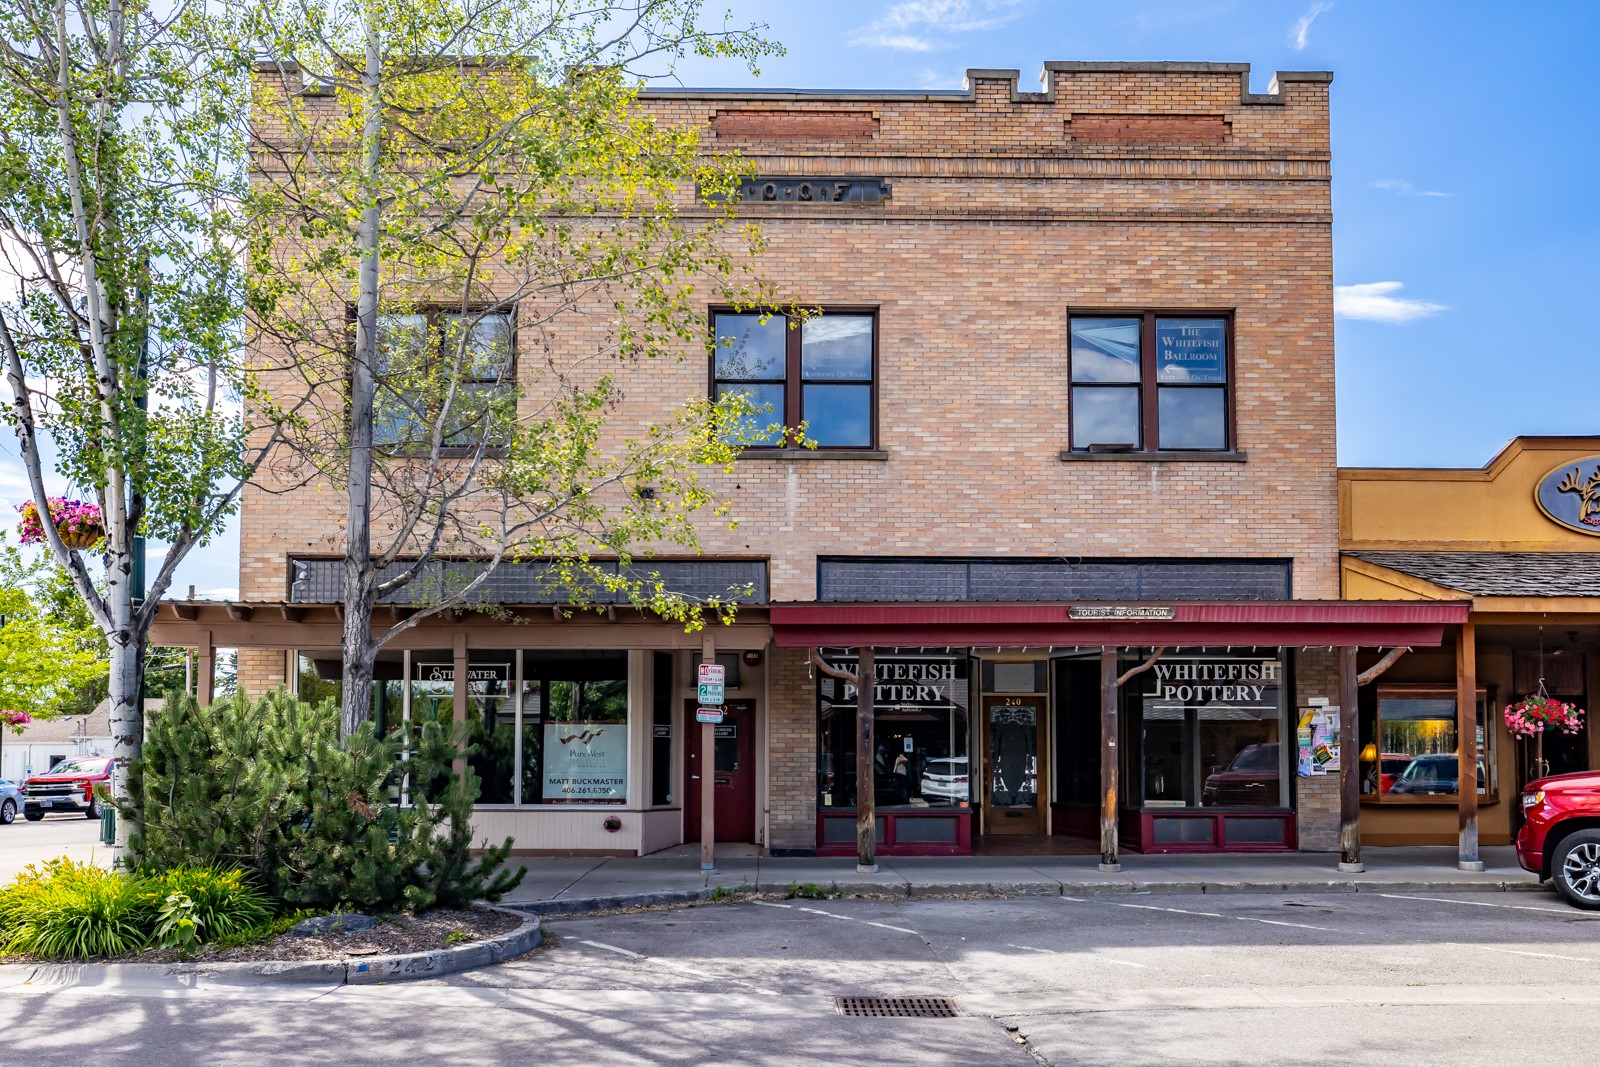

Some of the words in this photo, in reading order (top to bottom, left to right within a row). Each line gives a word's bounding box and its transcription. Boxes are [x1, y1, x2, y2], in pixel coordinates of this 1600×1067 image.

[1181, 326, 1200, 336] THE
[1162, 336, 1219, 347] WHITEFISH
[1164, 350, 1217, 360] BALLROOM
[1077, 609, 1110, 617] TOURIST
[1114, 609, 1168, 617] INFORMATION
[429, 666, 498, 681] STIATER
[700, 666, 708, 675] NO
[1153, 664, 1277, 680] WHITEFISH
[700, 685, 707, 696] 2
[843, 684, 946, 701] PTTERY
[1163, 685, 1266, 701] POTTERY
[1005, 698, 1021, 706] 240
